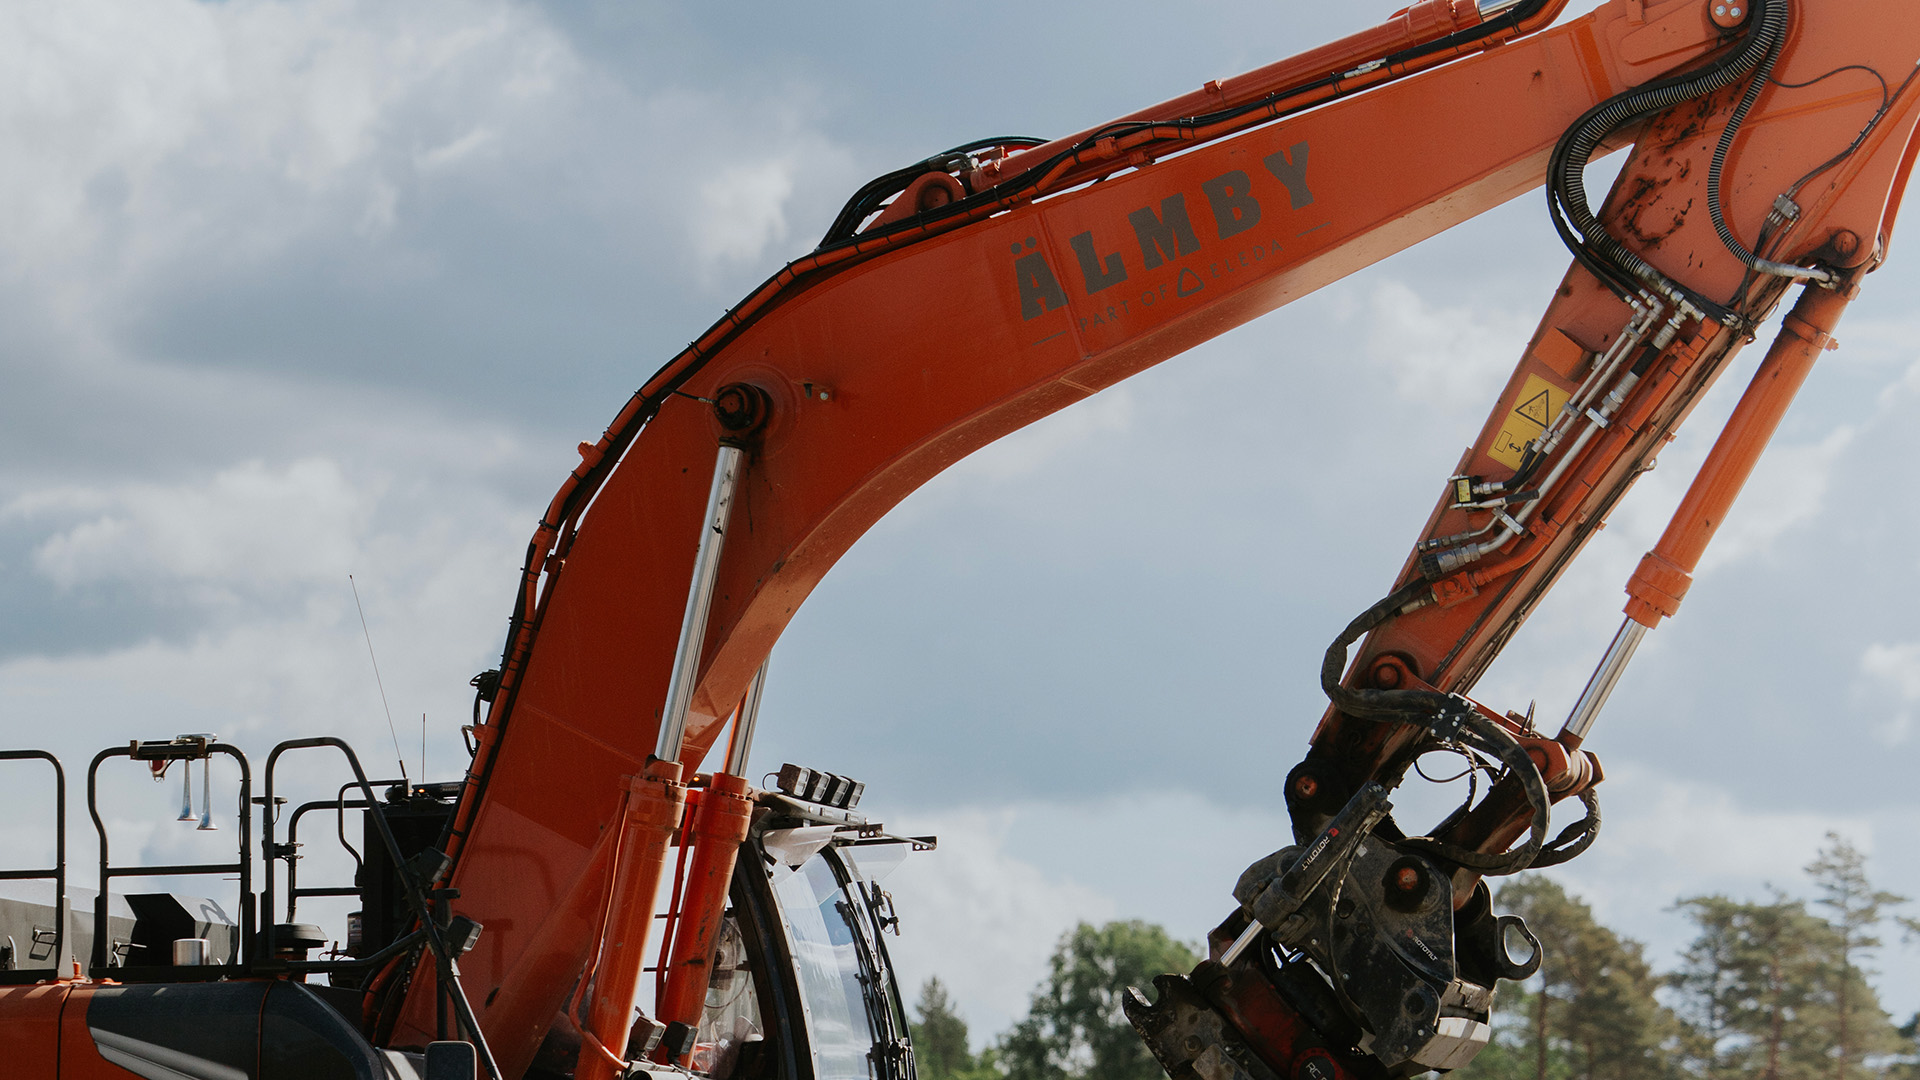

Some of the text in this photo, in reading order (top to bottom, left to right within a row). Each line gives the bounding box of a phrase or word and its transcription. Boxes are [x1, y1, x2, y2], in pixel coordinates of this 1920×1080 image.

[1010, 140, 1315, 321] ÄLMBY
[1079, 239, 1284, 332] PART OF ELEDA
[1301, 835, 1330, 871] ROTOTILT
[1412, 935, 1438, 961] ROTOTILT
